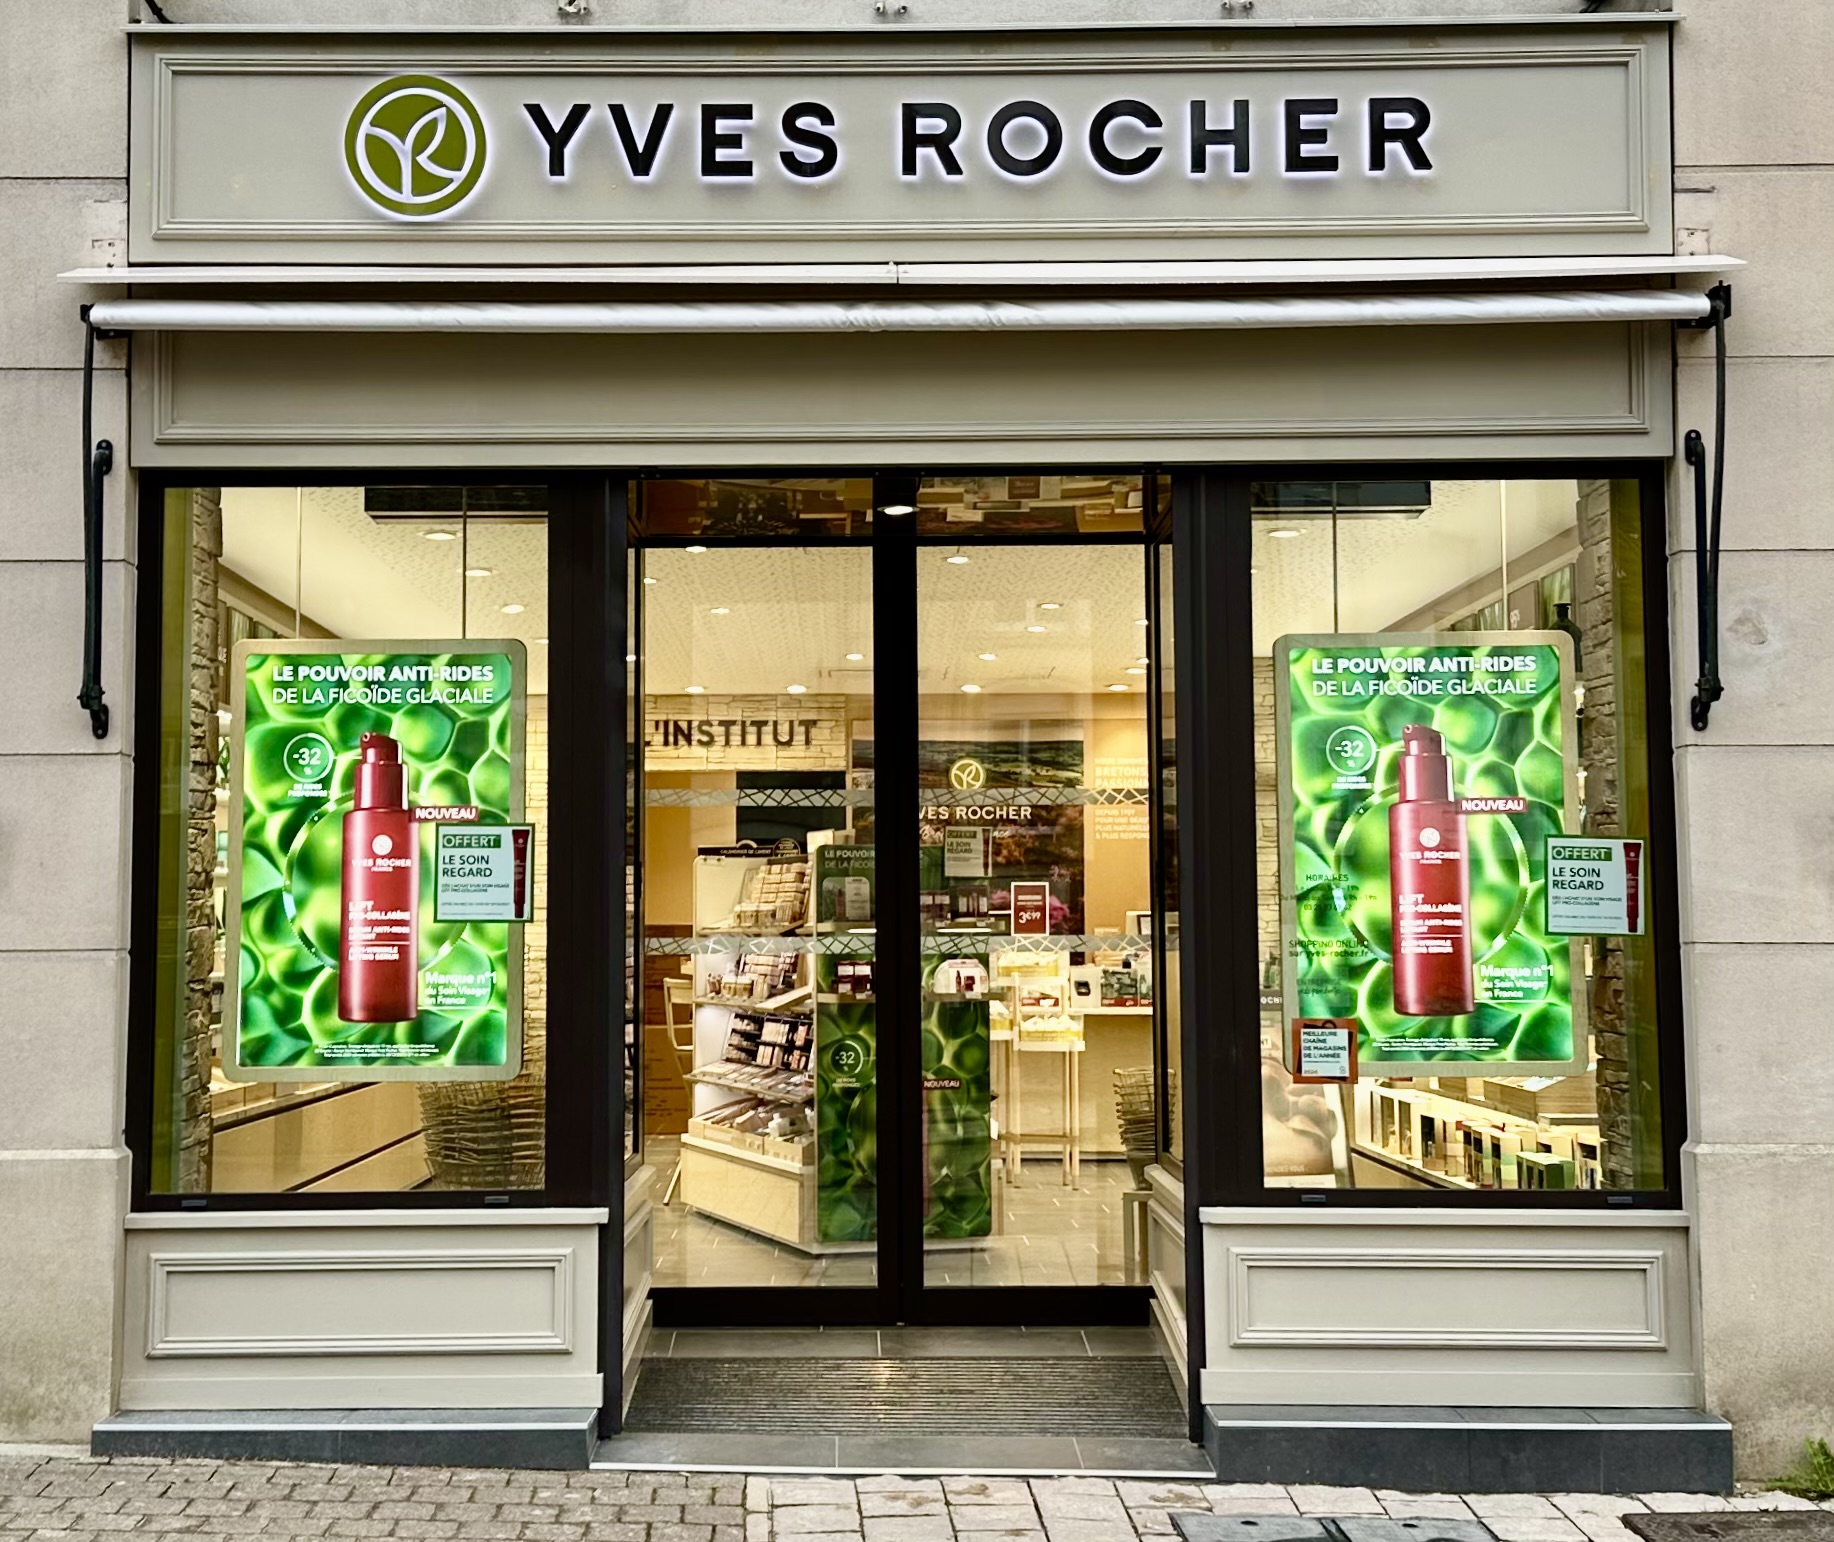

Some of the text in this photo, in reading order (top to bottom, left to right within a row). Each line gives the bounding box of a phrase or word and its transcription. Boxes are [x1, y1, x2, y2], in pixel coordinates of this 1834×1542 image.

[524, 97, 1433, 178] YVES ROCHER
[1312, 655, 1537, 674] LE POUVOIR ANTI-RIDES
[273, 665, 494, 682] LE POUVOIR ANTI-RIDES
[1313, 676, 1537, 696] DE LA FICOÏDE GLACIALE
[273, 684, 494, 704] DE LA FICOÏDE GLACIALE
[1334, 740, 1364, 758] -32
[293, 747, 321, 765] -32
[1461, 799, 1524, 811] NOUVEAU
[415, 807, 476, 819] NOUVEAU
[956, 805, 1032, 820] ROCHER
[443, 835, 496, 848] OFFERT
[825, 850, 833, 858] LE
[1423, 851, 1460, 860] ROCHER
[1552, 847, 1609, 860] OFFERT
[442, 854, 490, 866] LE SOIN
[442, 867, 493, 878] REGARD
[1552, 867, 1601, 878] LE SOIN
[1552, 880, 1604, 891] REGARD
[1480, 964, 1531, 980] Marque
[425, 971, 474, 986] Marque
[1494, 989, 1523, 998] France
[437, 996, 466, 1004] France
[835, 1052, 855, 1064] -32
[924, 1080, 960, 1088] NOUVEAU
